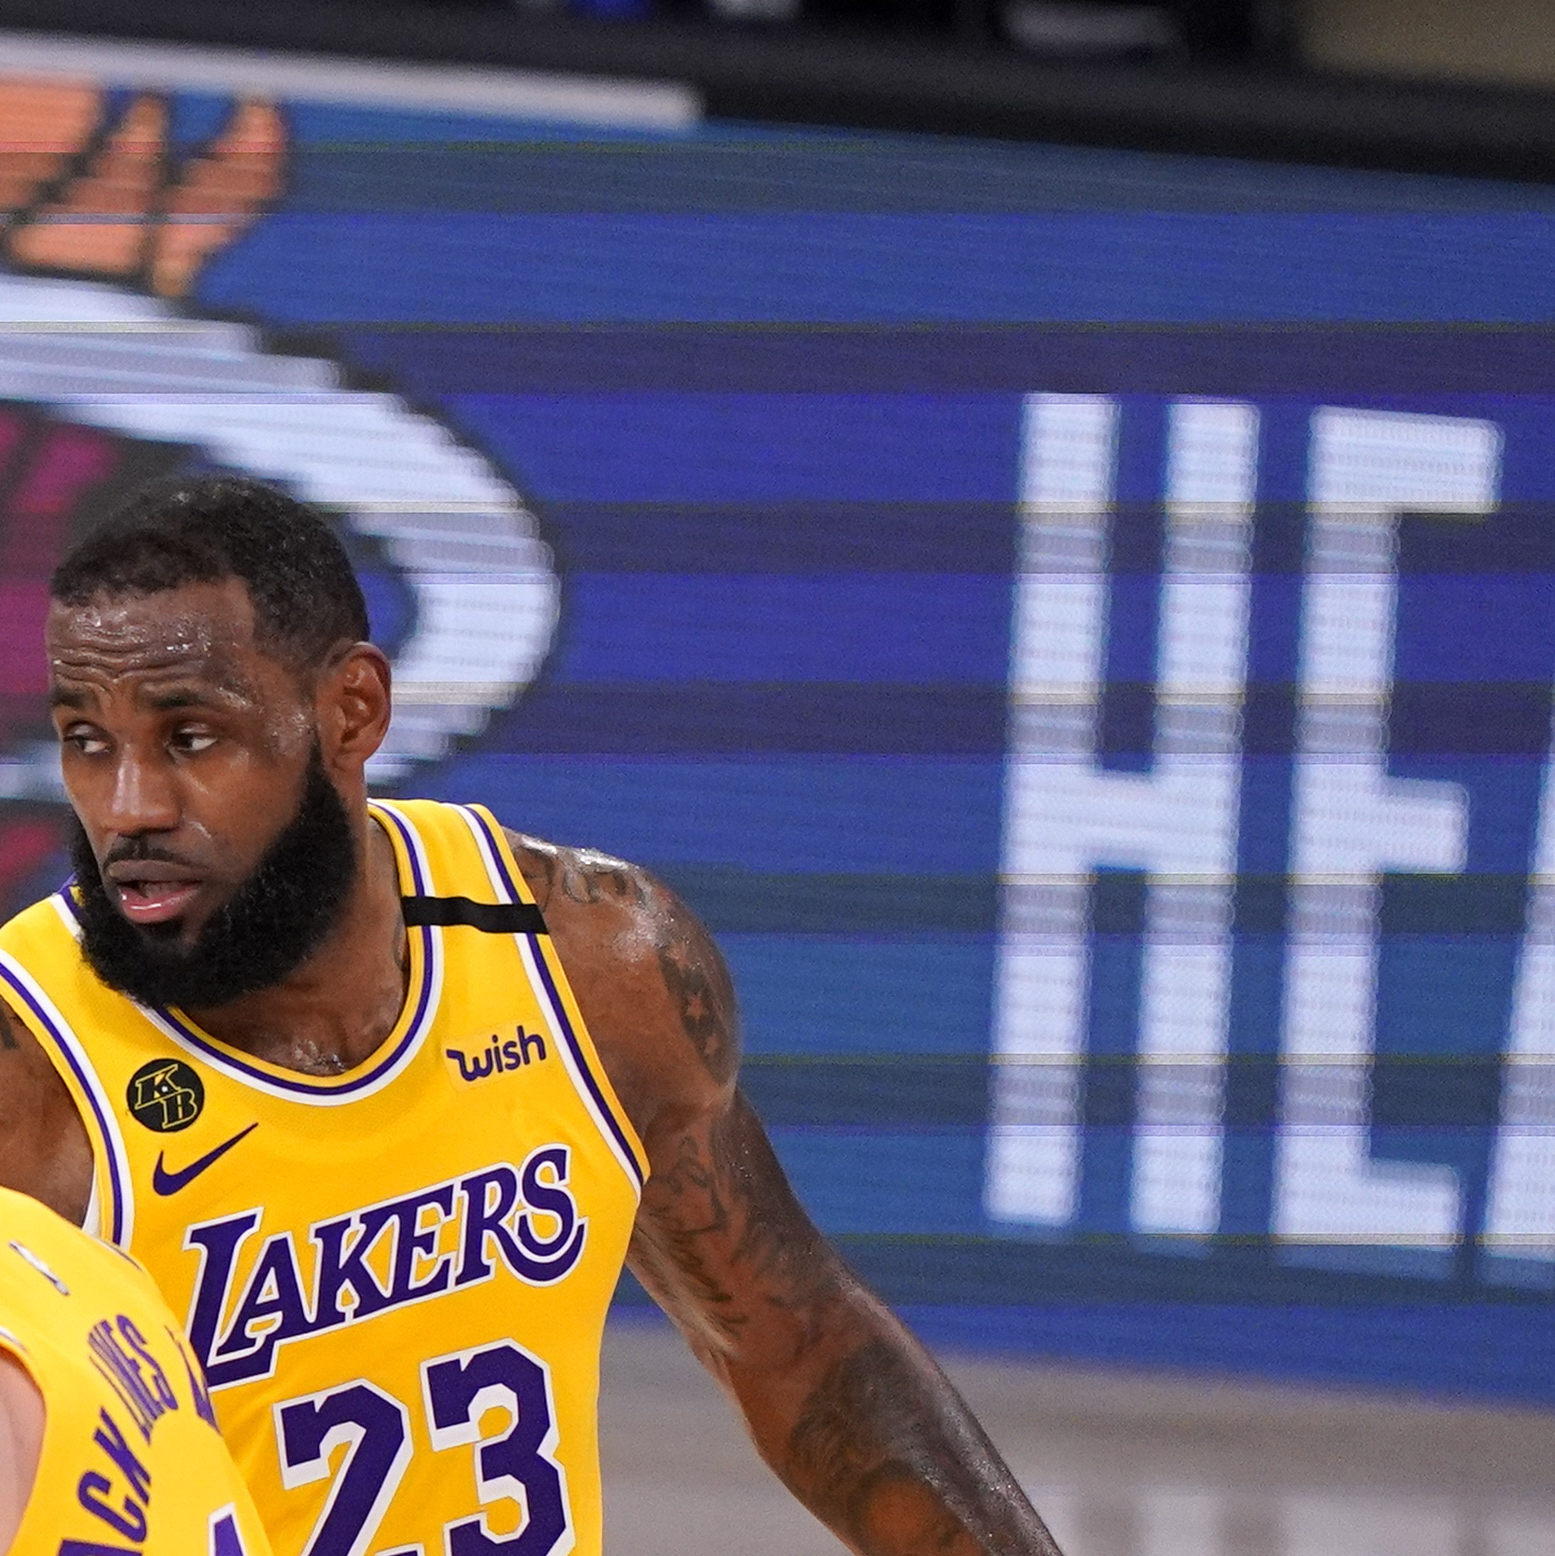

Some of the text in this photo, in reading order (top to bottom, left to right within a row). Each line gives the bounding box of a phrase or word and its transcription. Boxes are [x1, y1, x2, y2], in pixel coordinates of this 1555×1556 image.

[983, 392, 1555, 1262] HE
[446, 1025, 547, 1082] wish
[183, 1143, 589, 1390] LAKERS
